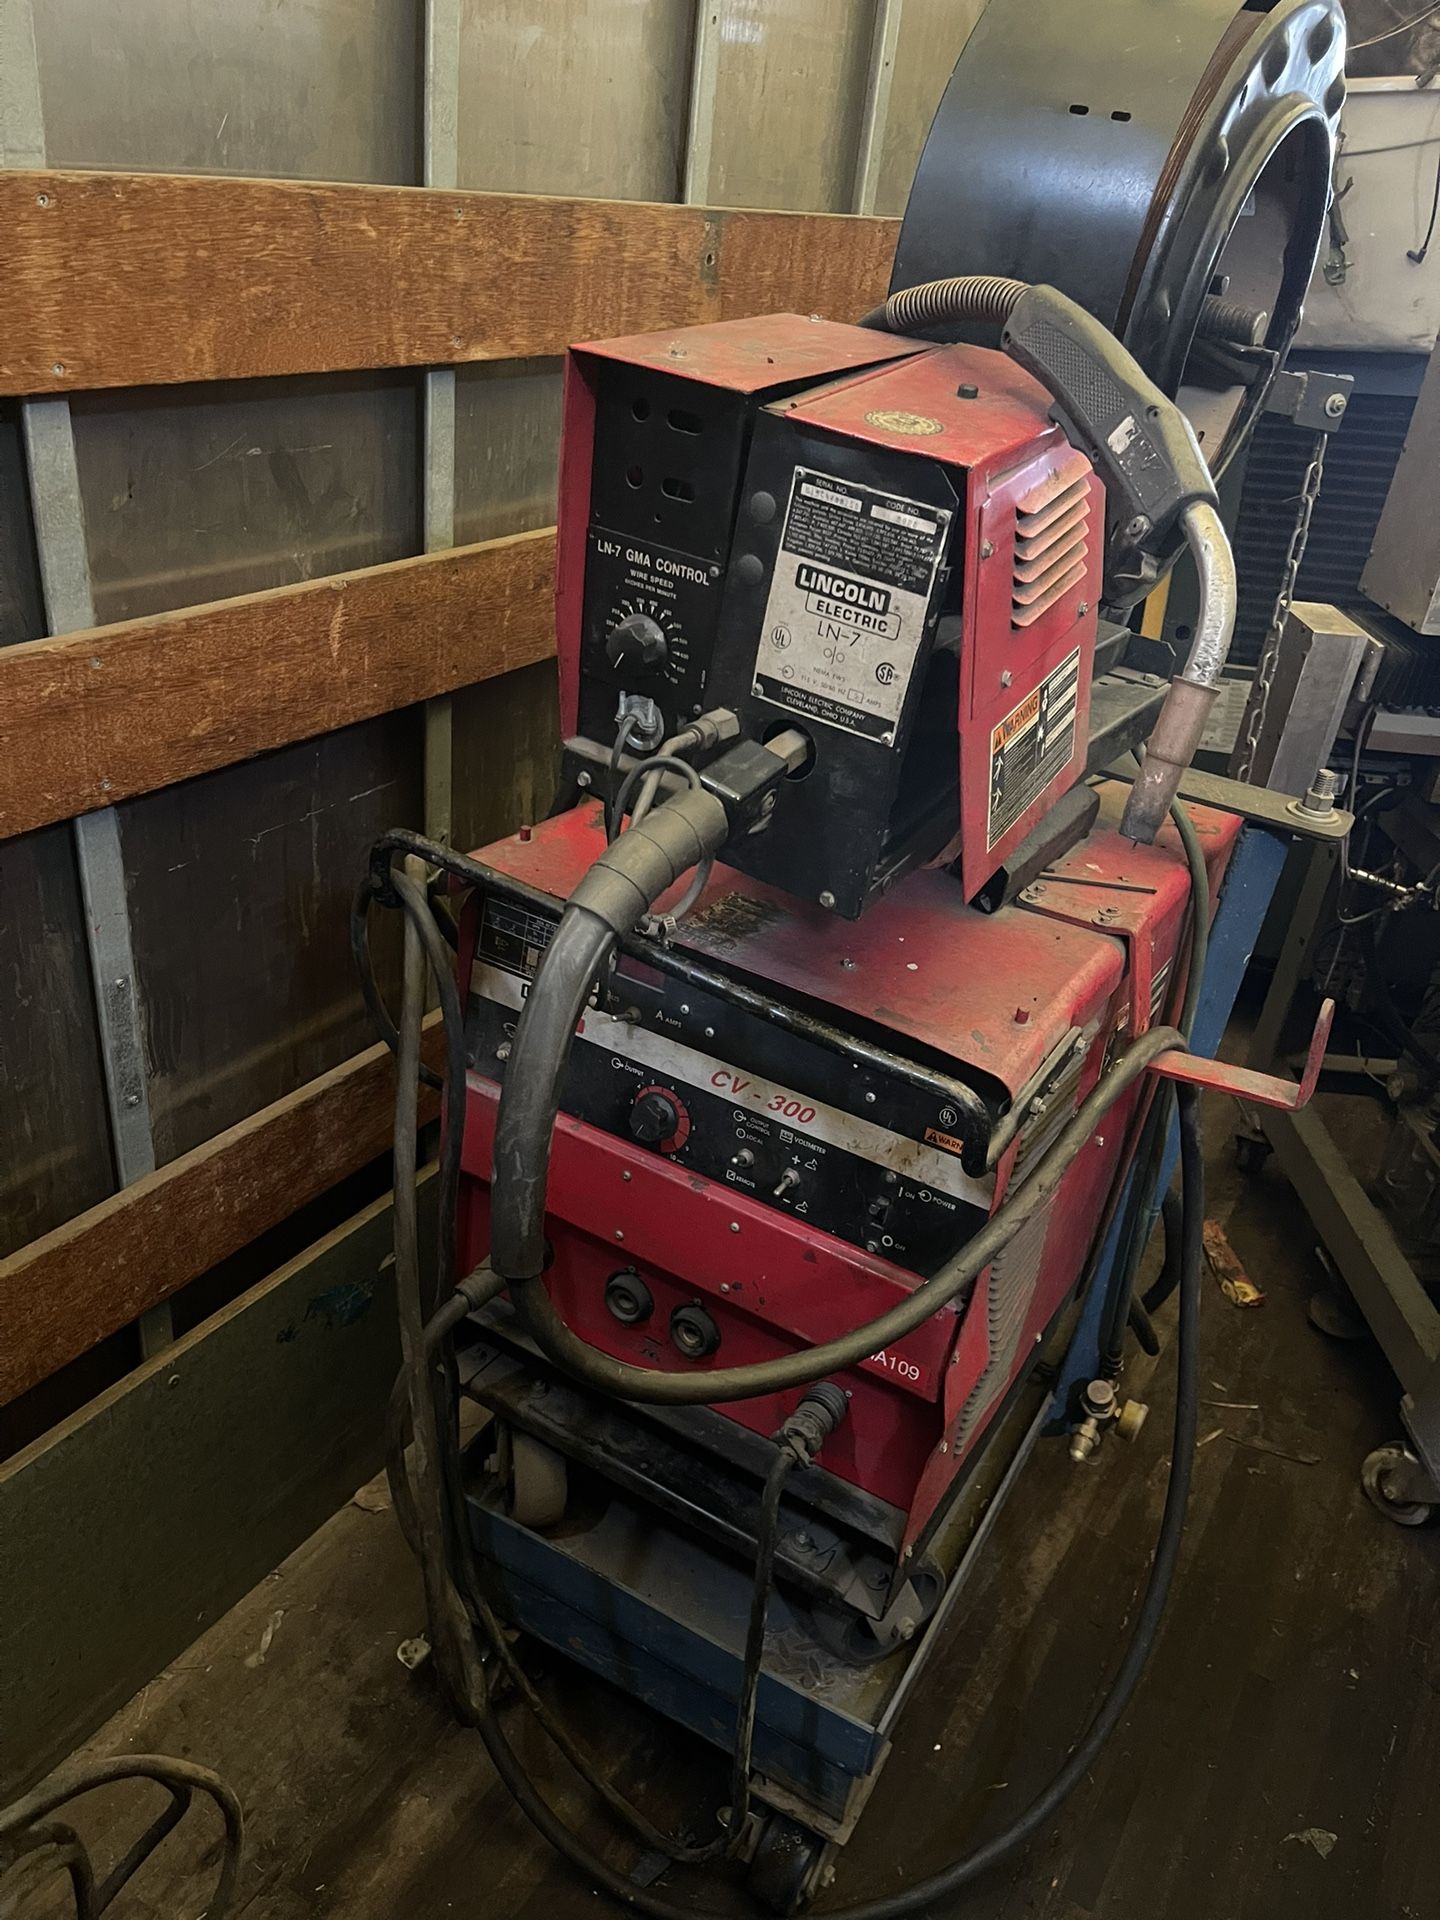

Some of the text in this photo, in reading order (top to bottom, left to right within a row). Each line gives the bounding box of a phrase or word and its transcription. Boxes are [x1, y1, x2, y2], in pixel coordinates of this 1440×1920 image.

[816, 478, 848, 494] SERIAL NO.
[886, 500, 920, 516] CODE NO.
[598, 540, 710, 586] LN-7 GMA CONTROL
[630, 569, 674, 588] WIRE SPEED
[656, 588, 677, 600] MINUTE
[800, 568, 886, 612] LINCOLN
[816, 600, 888, 632] ELECTRIC
[818, 620, 862, 647] LN-7
[781, 686, 866, 720] LINCOLN ELECTRIC COMPANY
[821, 708, 838, 720] OHIO
[1003, 695, 1038, 742] WARNING
[665, 1018, 682, 1028] AMPS
[624, 1063, 644, 1076] OUTPUT
[710, 1070, 750, 1094] CV
[768, 1095, 816, 1124] 300
[746, 1122, 770, 1136] CONTROL
[750, 1116, 770, 1129] OUTPUT
[746, 1134, 764, 1145] LOCAL
[794, 1136, 826, 1155] VOLTMETER
[736, 1175, 756, 1188] REMOTE
[904, 1192, 915, 1200] ON
[934, 1196, 956, 1211] POWER
